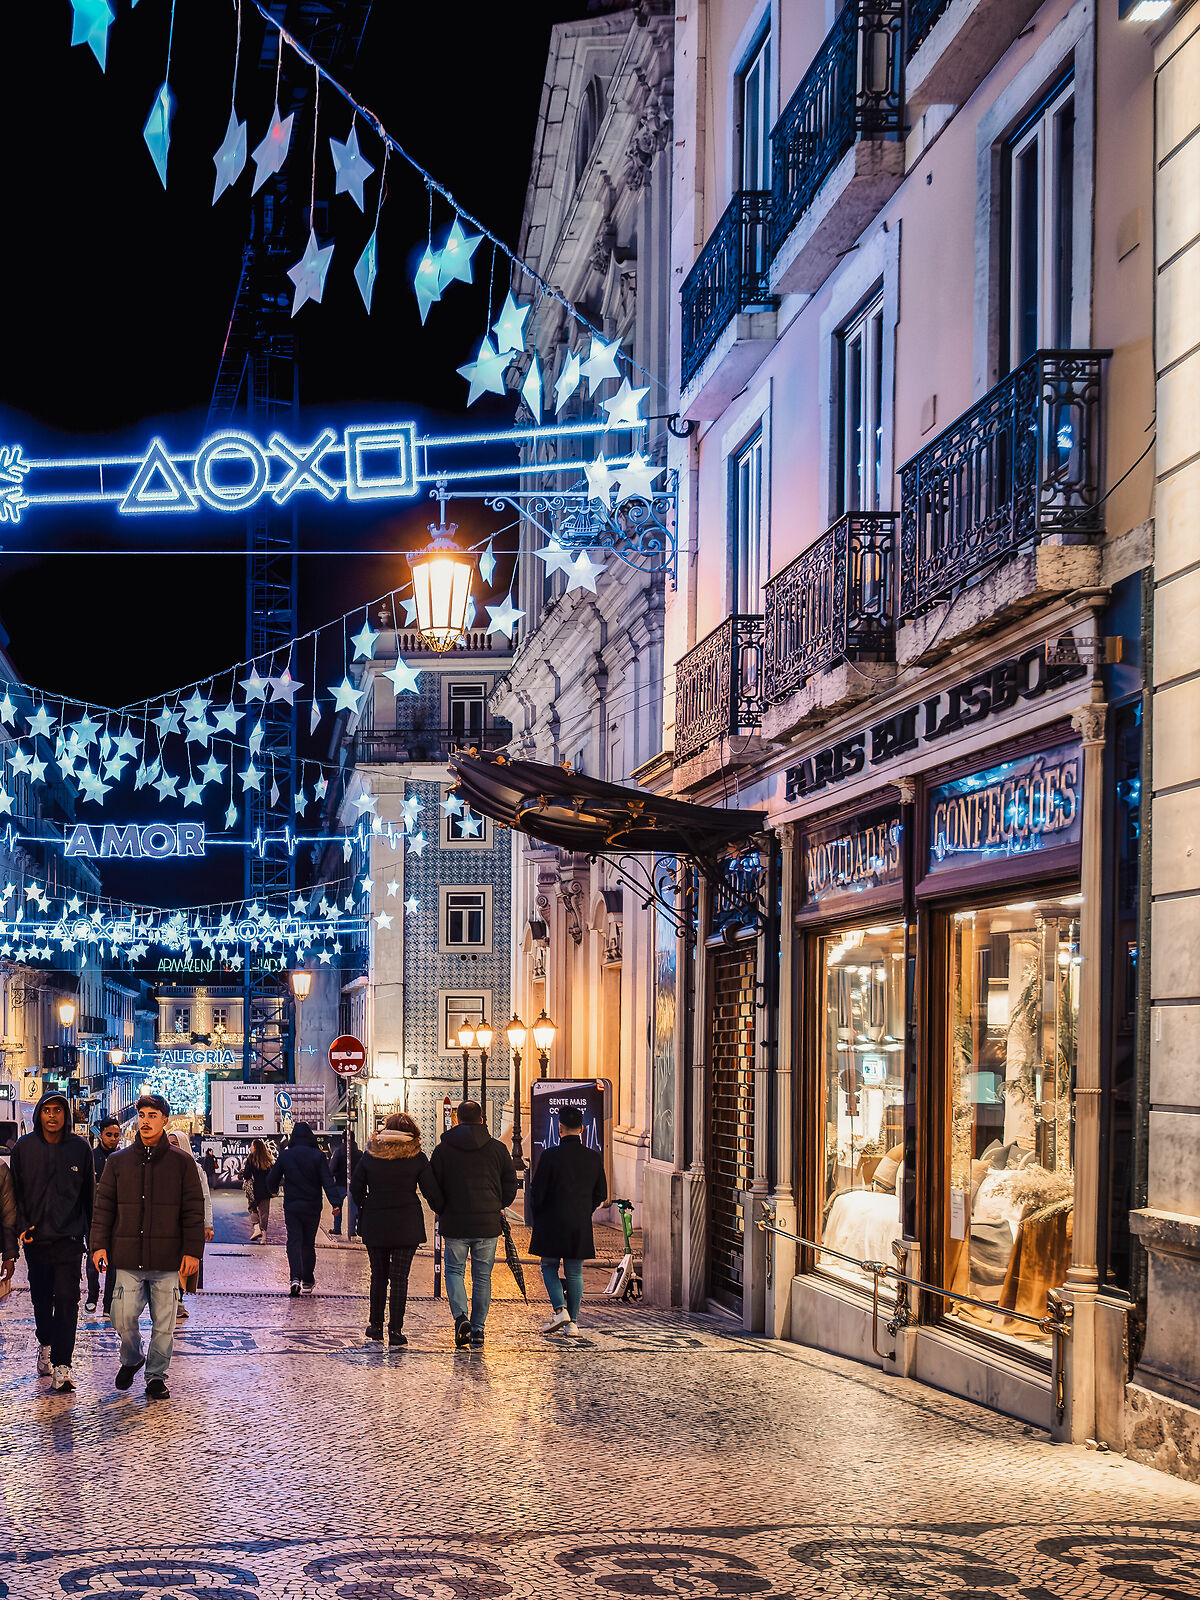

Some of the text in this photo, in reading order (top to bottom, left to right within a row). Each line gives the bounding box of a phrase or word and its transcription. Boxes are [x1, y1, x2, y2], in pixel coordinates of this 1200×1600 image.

[785, 733, 865, 801] PARIS
[869, 705, 919, 765] EM
[923, 630, 1087, 742] LISBOA
[64, 823, 206, 858] AMOR
[807, 819, 900, 894] NOVIDADES
[161, 1050, 236, 1063] ALEGRIA
[548, 1098, 587, 1106] SENTE MAIS
